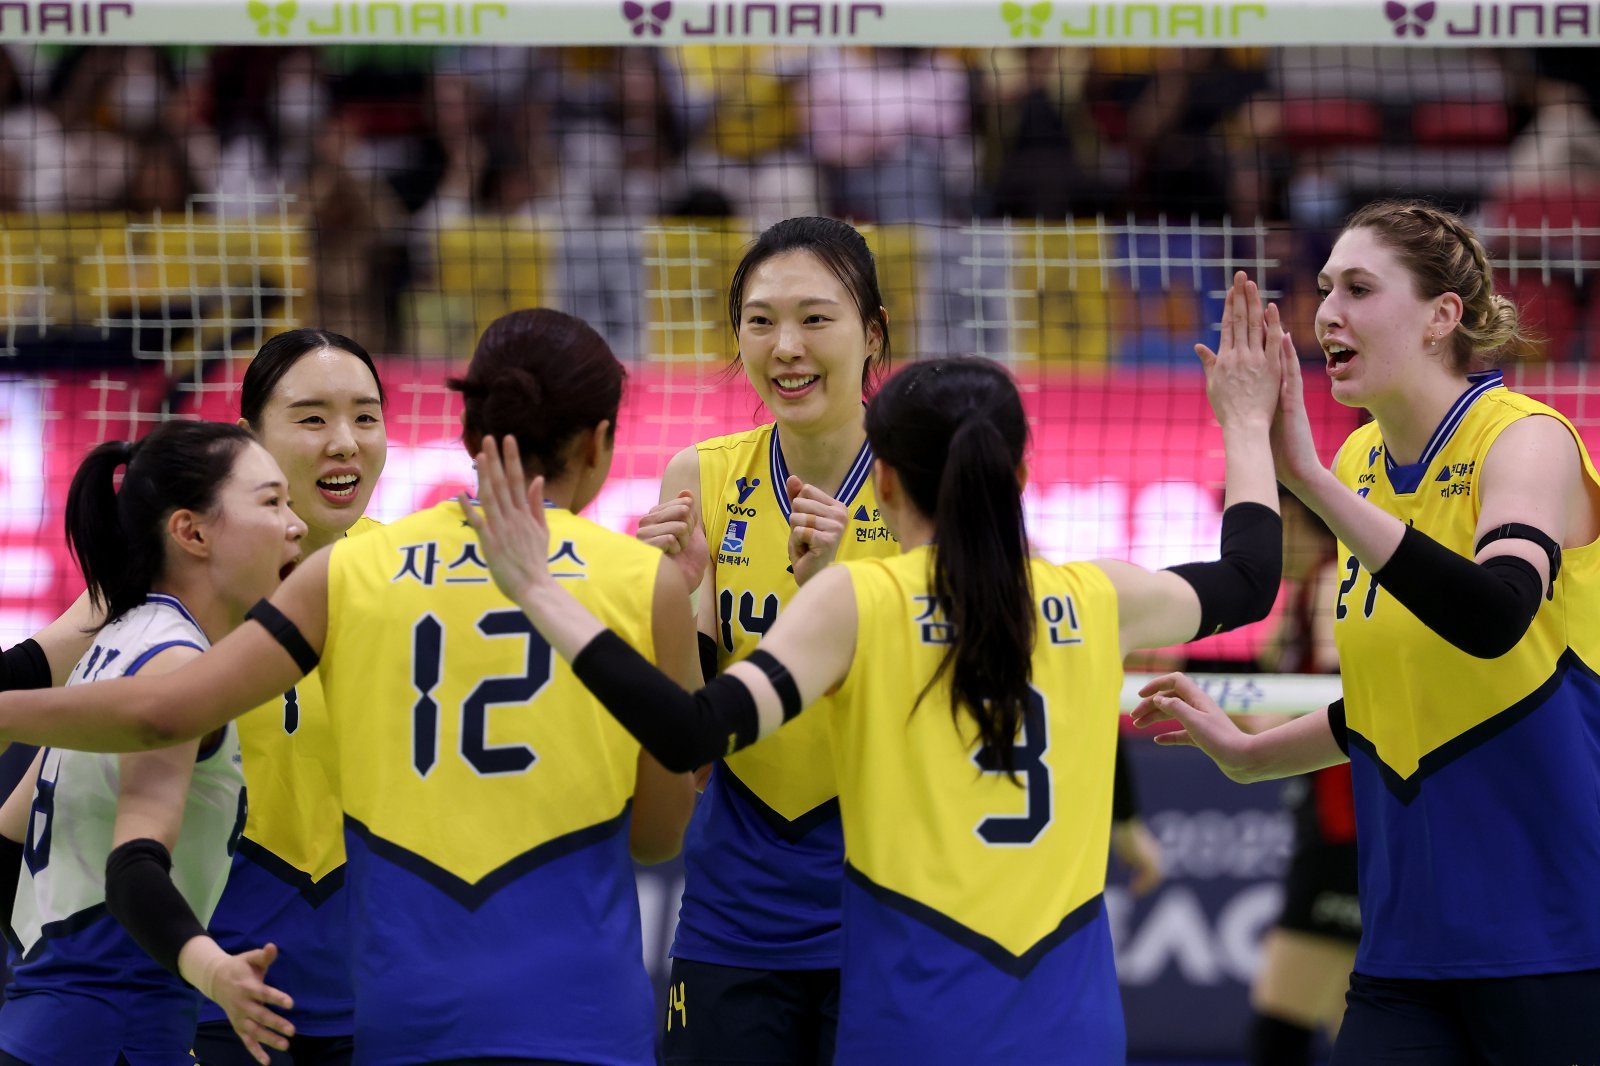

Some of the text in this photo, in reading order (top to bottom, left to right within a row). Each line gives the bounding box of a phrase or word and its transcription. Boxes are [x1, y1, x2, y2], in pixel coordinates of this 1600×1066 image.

[307, 3, 506, 35] JINAIR
[682, 4, 882, 36] JINAIR
[1061, 4, 1267, 38] JINAIR
[1446, 4, 1600, 37] JINA
[392, 541, 587, 586] 자스스
[718, 553, 750, 567] 원특례시
[718, 588, 779, 655] 14
[913, 594, 1083, 645] 김인
[411, 607, 554, 779] 12
[970, 681, 1053, 846] 3
[667, 980, 687, 1032] 14
